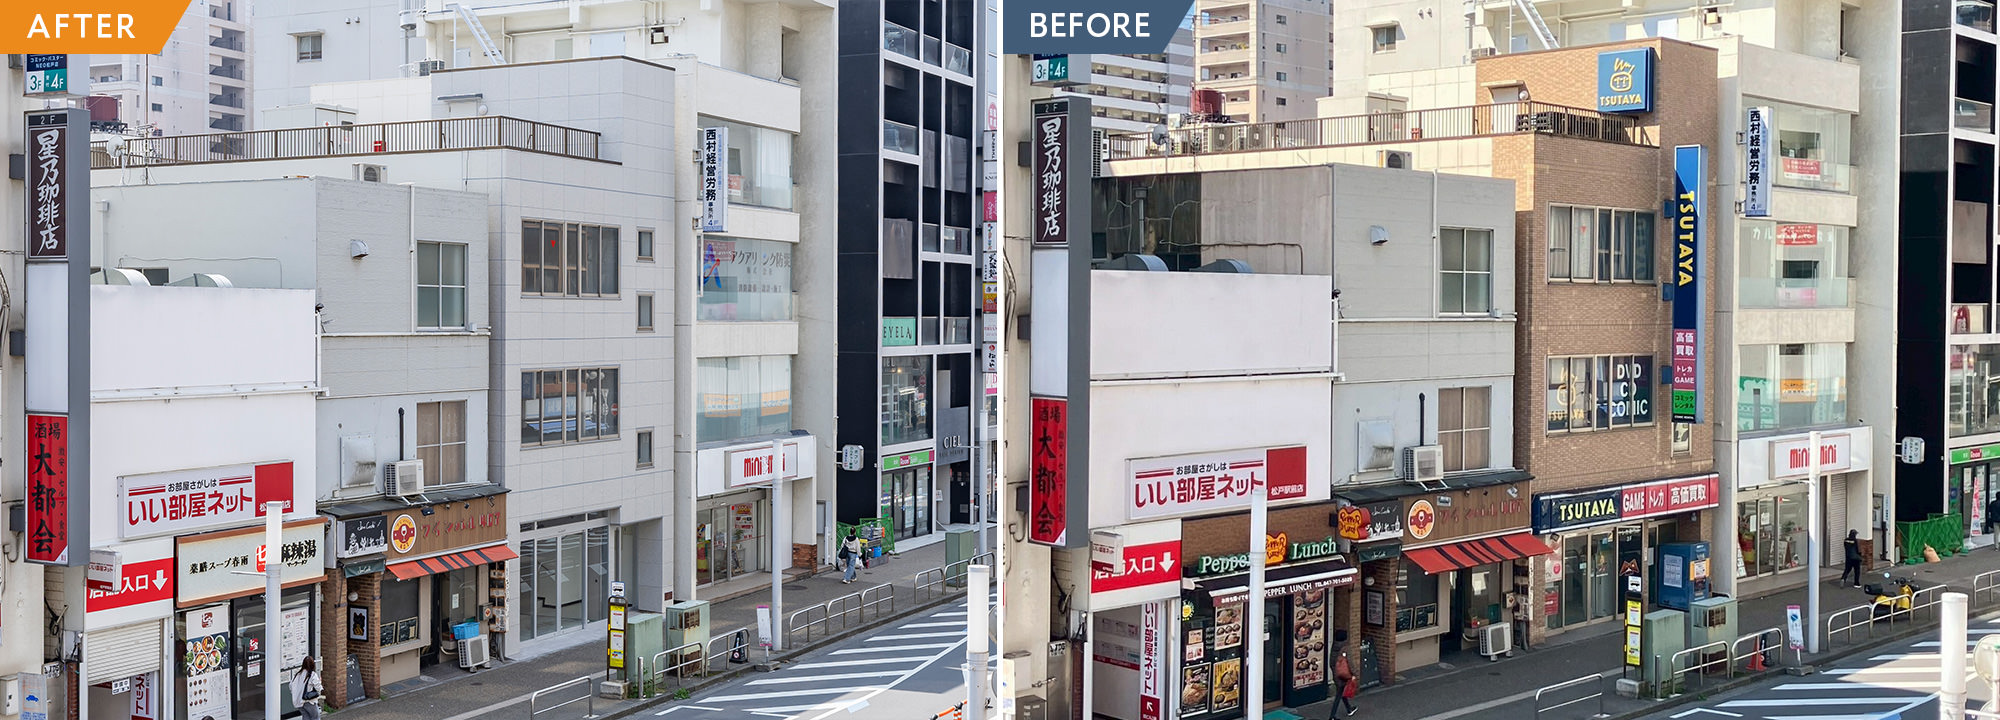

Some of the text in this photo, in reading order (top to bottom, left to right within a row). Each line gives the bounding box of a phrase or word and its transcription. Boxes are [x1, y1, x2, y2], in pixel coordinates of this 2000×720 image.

[1036, 64, 1047, 79] 3F
[1054, 61, 1066, 78] 4F
[30, 75, 41, 90] 3F
[51, 73, 64, 89] 4F
[1600, 94, 1642, 107] TSUTAYA
[1041, 117, 1062, 240] 星乃珈琲店
[36, 129, 60, 255] 星乃珈琲店
[1678, 191, 1695, 286] TSUTAYA
[943, 435, 962, 449] CIEL
[1176, 462, 1227, 475] お部屋さがしは
[167, 479, 217, 493] お部屋さがしは
[1036, 426, 1056, 535] 大都会
[1135, 471, 1264, 508] いい部屋ネット
[31, 443, 57, 554] 大都会
[1622, 491, 1645, 512] GAME
[1648, 489, 1665, 508] トレカ
[1670, 484, 1707, 505] 高価買取
[128, 487, 252, 526] いい部屋ネット
[1560, 498, 1616, 522] TSUTAYA
[1292, 537, 1337, 560] Lunch
[189, 555, 249, 574] 薬膳スープ春雨
[1264, 586, 1286, 598] PEPPER
[1290, 582, 1312, 593] LUNCH
